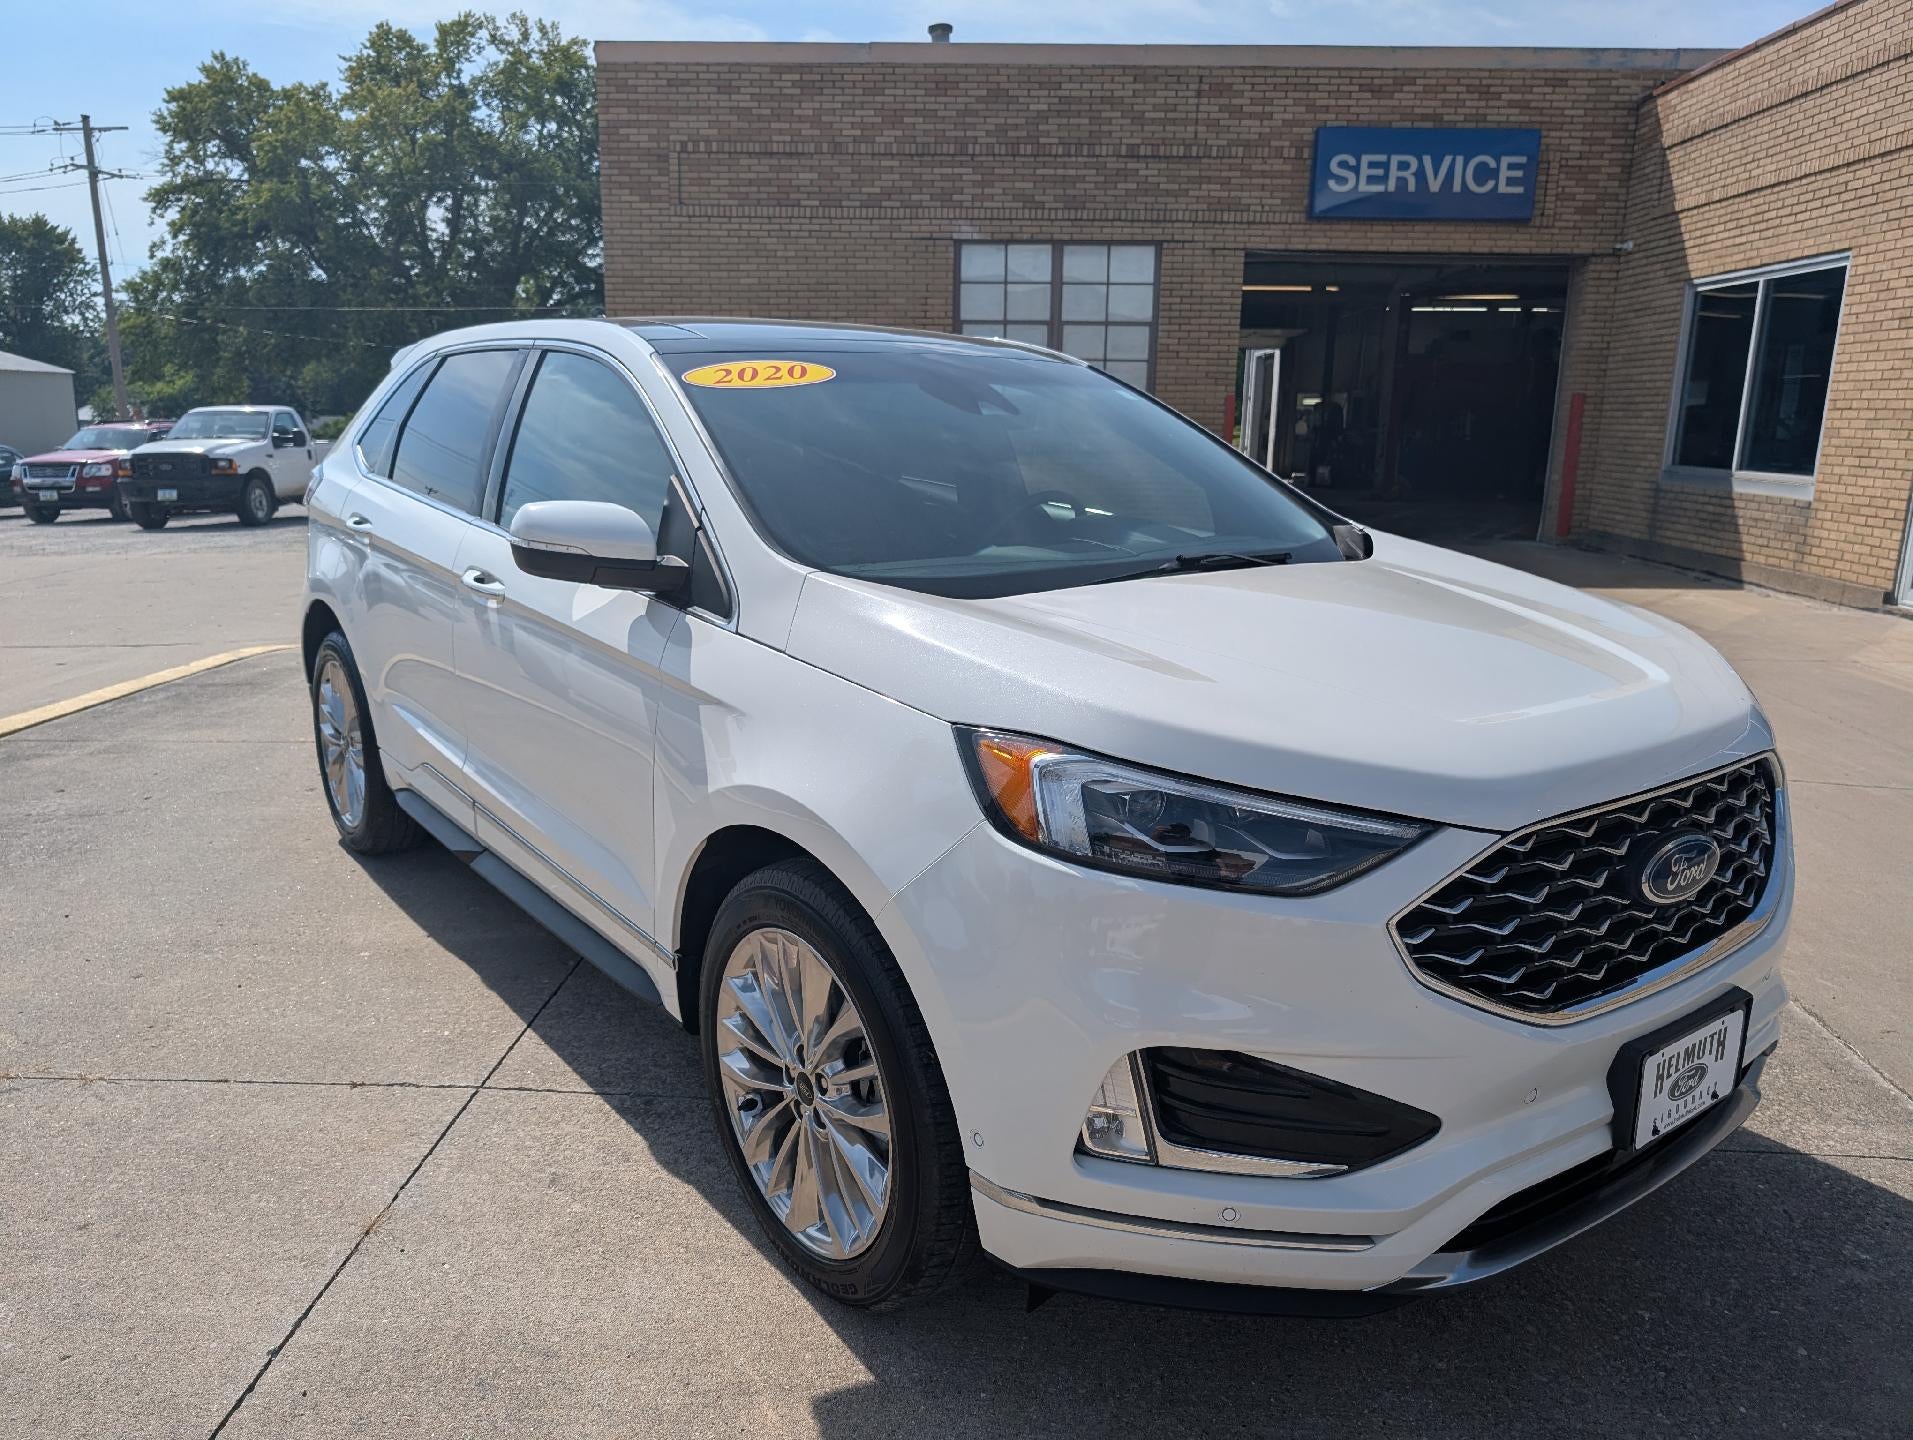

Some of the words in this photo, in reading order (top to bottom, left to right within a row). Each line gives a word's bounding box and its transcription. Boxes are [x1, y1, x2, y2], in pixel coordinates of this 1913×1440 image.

[1327, 153, 1528, 194] SERVICE
[713, 363, 808, 385] 2020
[1666, 849, 1708, 891] Ford
[1653, 1026, 1728, 1099] HELMUTH
[1673, 1068, 1701, 1096] Ford
